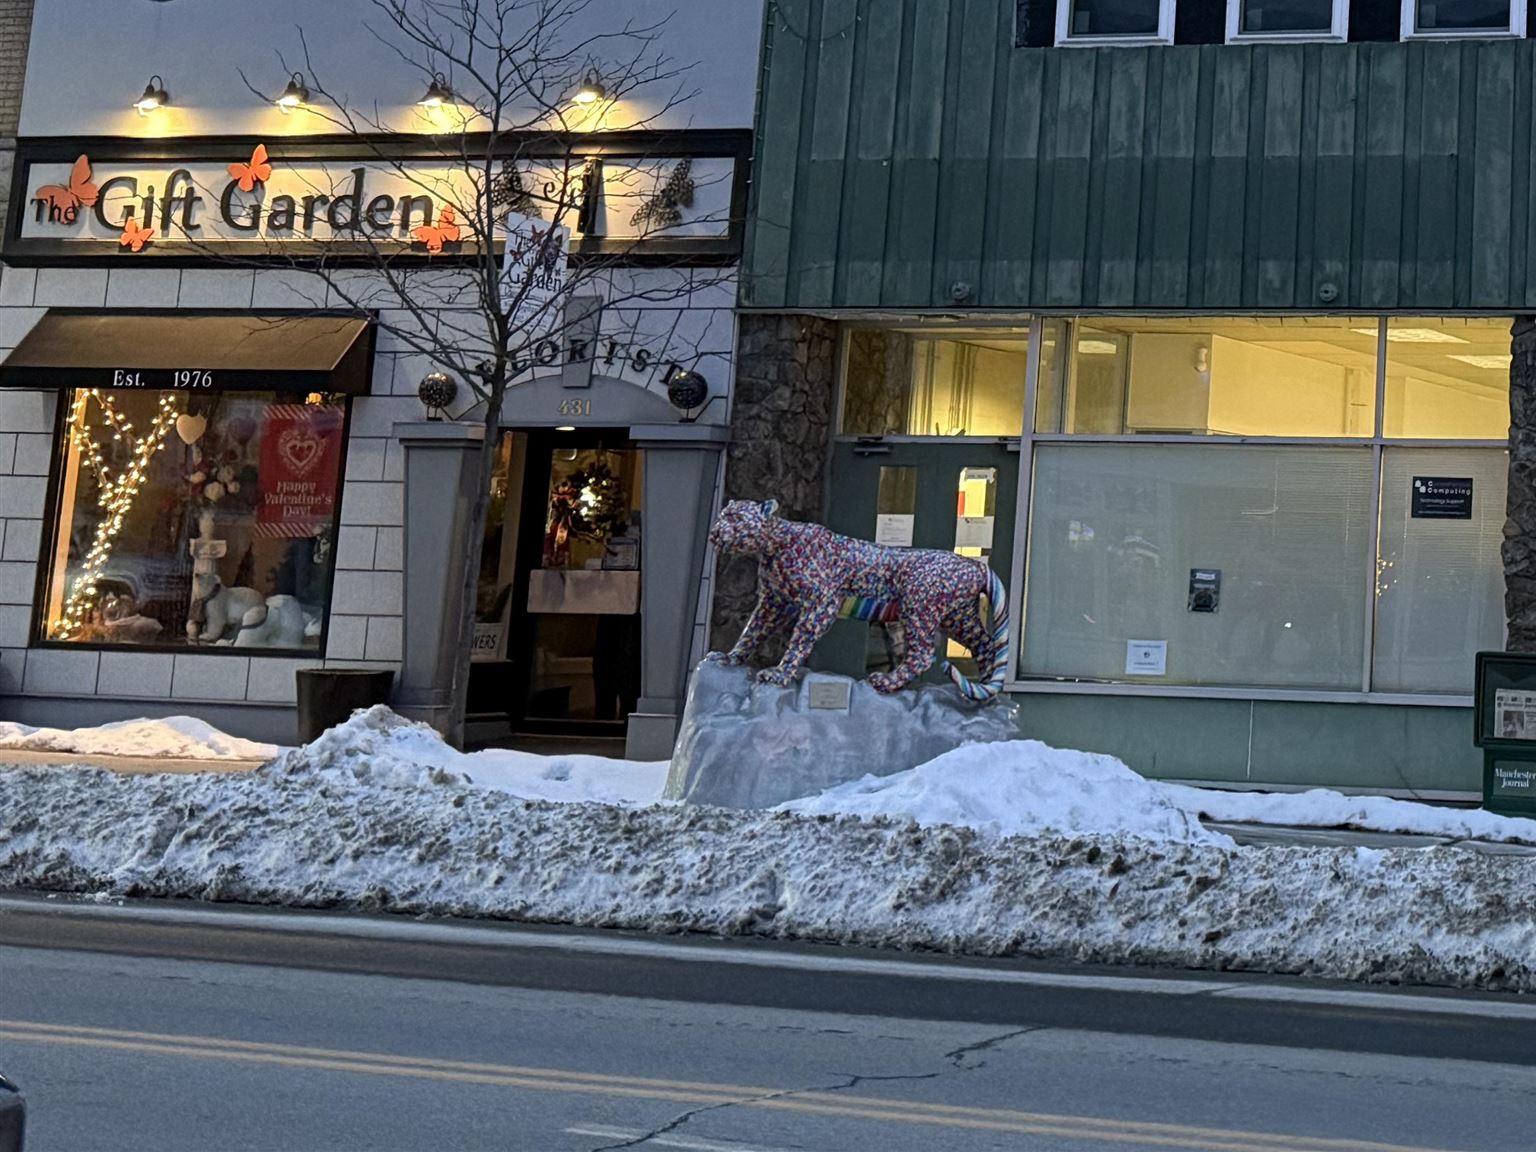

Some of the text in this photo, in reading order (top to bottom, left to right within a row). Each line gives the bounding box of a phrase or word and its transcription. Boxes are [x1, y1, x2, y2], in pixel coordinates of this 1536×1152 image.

[30, 167, 434, 233] The Gift Garden
[113, 369, 212, 387] Est. 1976
[558, 399, 591, 416] 431
[276, 480, 316, 494] Happy
[264, 492, 332, 505] Valentine's
[283, 505, 311, 518] Day!
[1501, 777, 1530, 789] Journal
